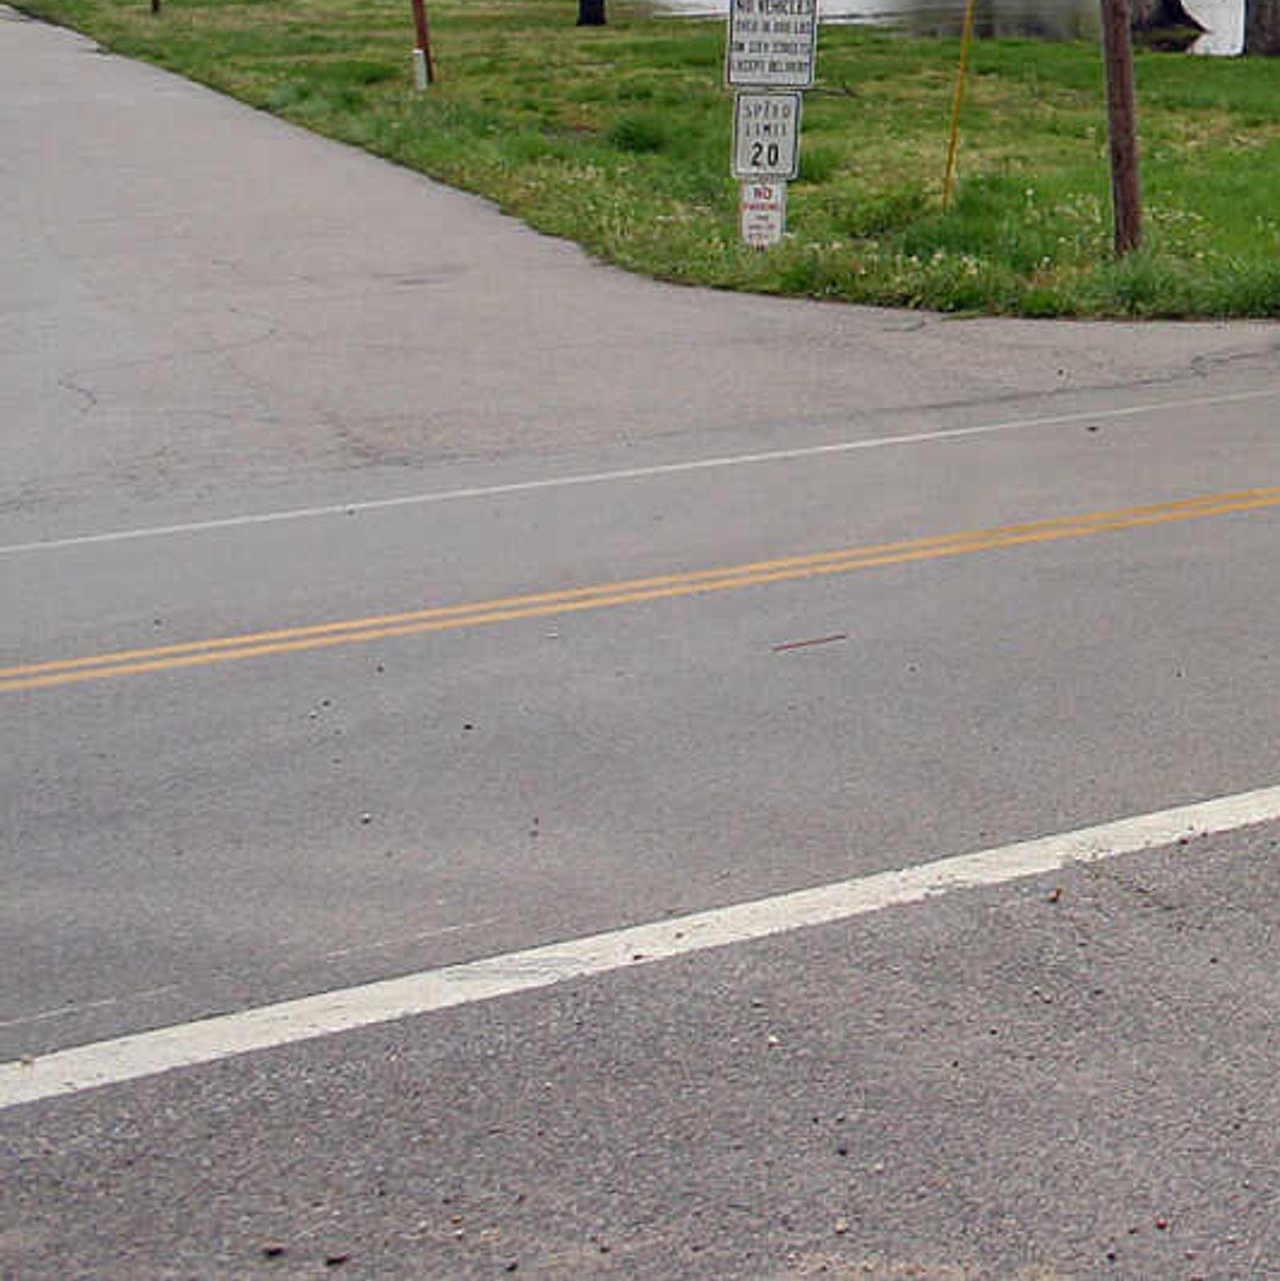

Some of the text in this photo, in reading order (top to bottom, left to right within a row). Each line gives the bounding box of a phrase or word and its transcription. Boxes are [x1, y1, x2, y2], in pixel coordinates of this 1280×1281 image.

[745, 103, 791, 118] SPEED
[745, 122, 787, 137] LIMIT
[751, 141, 779, 167] 20
[753, 187, 772, 200] NO
